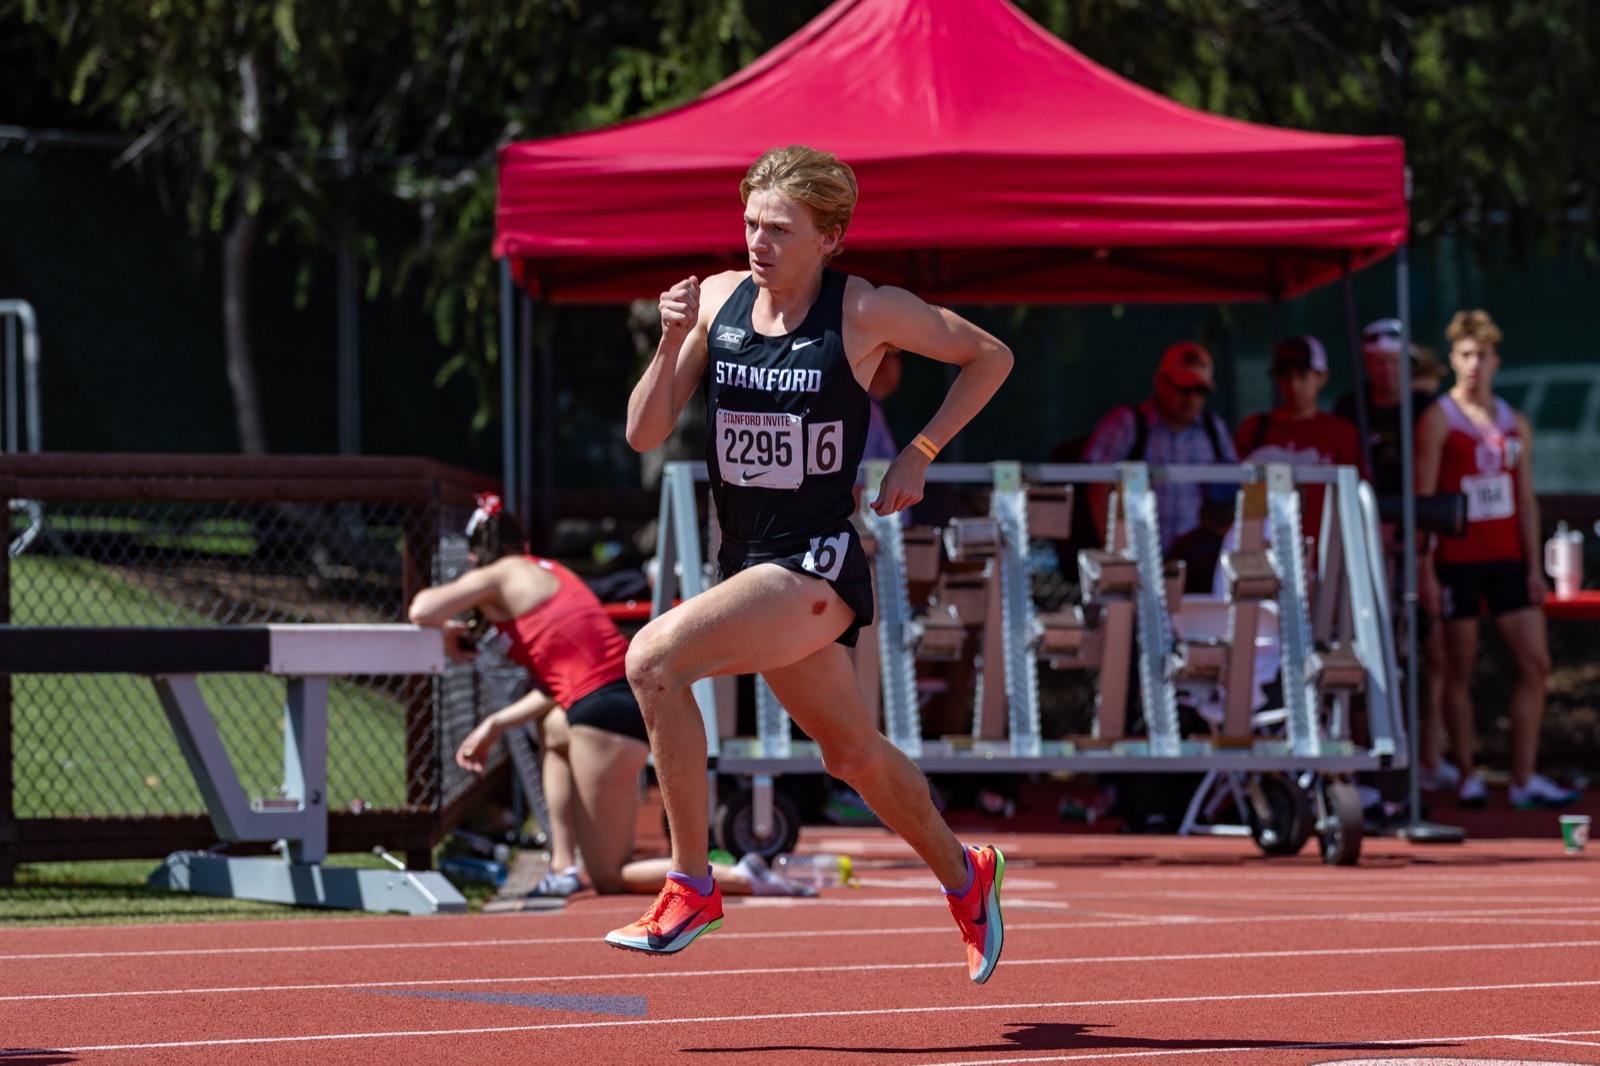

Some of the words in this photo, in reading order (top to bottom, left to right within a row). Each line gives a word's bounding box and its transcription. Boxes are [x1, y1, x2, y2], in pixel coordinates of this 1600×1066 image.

[716, 331, 743, 344] ACC
[716, 360, 822, 392] STANFORD
[723, 412, 760, 427] STANFORD
[763, 415, 791, 427] INVITE
[724, 427, 793, 467] 2295
[815, 424, 837, 472] 6
[813, 534, 841, 574] 6
